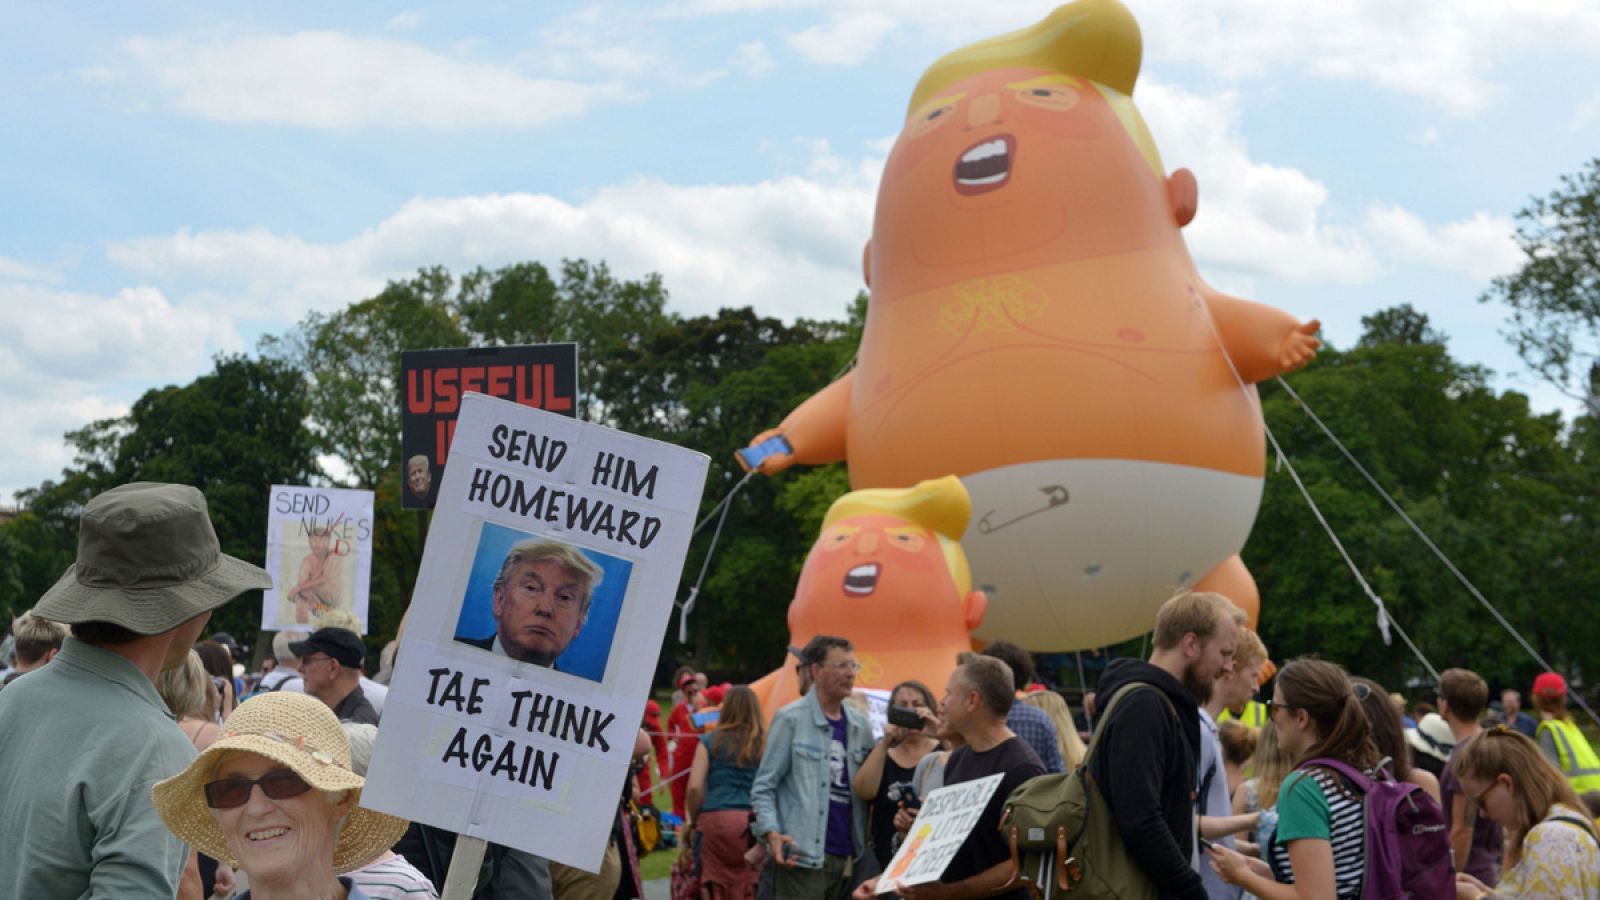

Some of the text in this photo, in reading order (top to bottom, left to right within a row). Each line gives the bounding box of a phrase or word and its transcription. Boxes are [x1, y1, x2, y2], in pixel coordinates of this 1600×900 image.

[487, 424, 568, 473] SEND
[591, 451, 659, 500] HIM
[276, 492, 330, 515] SEND
[468, 468, 662, 549] HOMEWARD
[426, 668, 616, 752] TAE THINK
[442, 727, 560, 791] AGAIN
